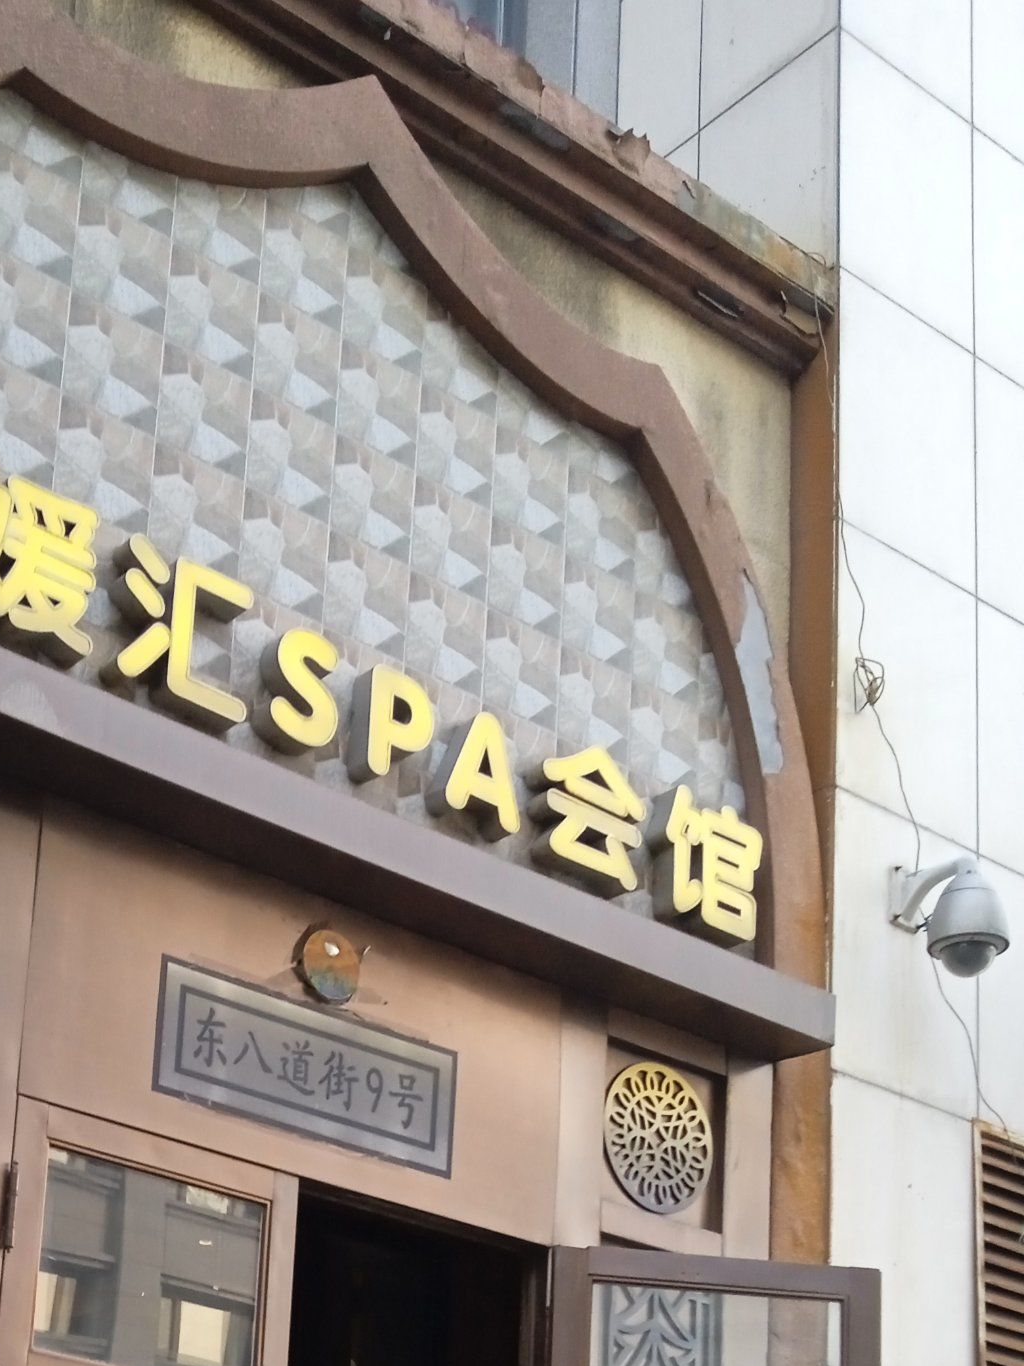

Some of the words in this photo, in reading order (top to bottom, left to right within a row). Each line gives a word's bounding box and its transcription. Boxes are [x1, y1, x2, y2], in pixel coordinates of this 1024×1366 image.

[193, 1007, 424, 1129] 东八道街9号
